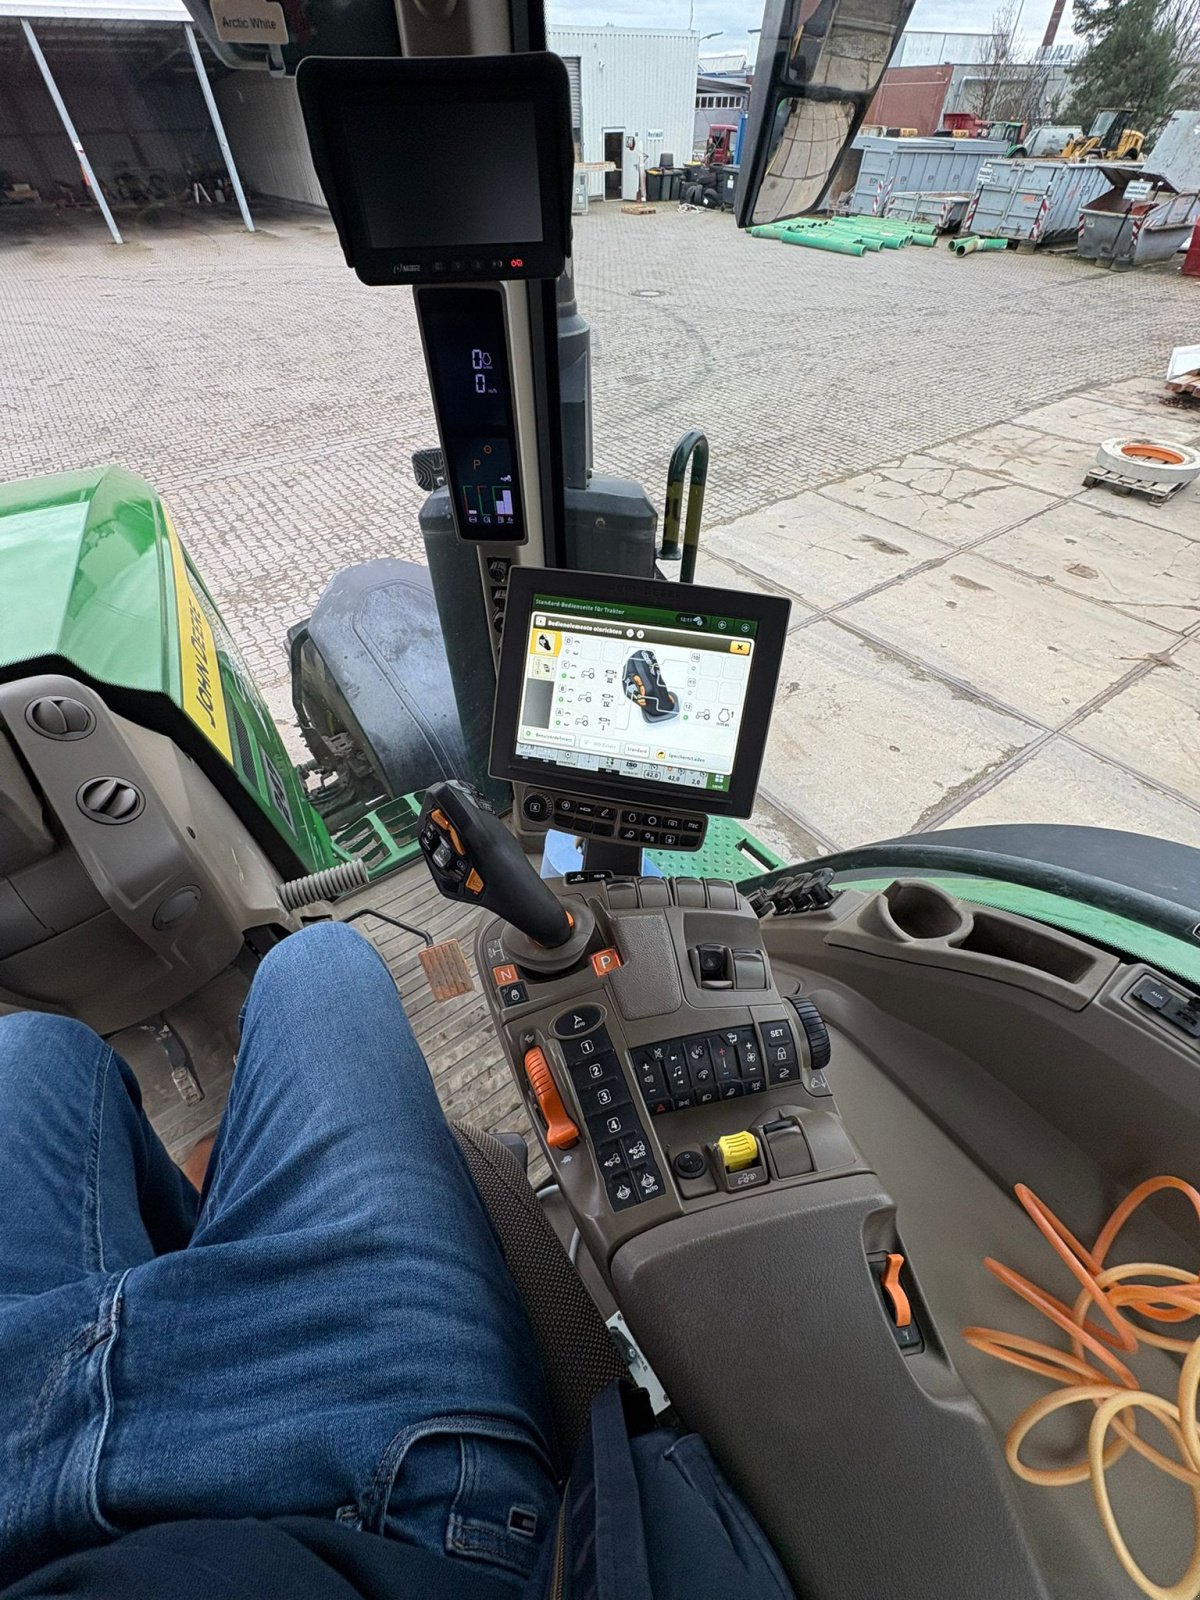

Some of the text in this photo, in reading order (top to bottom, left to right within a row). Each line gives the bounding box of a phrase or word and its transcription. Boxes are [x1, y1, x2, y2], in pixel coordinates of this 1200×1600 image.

[222, 16, 277, 30] Arctic White
[604, 607, 625, 615] Traktor
[195, 655, 216, 729] JOHN
[600, 955, 611, 969] P
[500, 969, 512, 979] N
[1150, 990, 1163, 1001] AUX
[770, 1028, 784, 1038] SET
[632, 1150, 647, 1160] AUTO
[645, 1184, 659, 1194] AUTO
